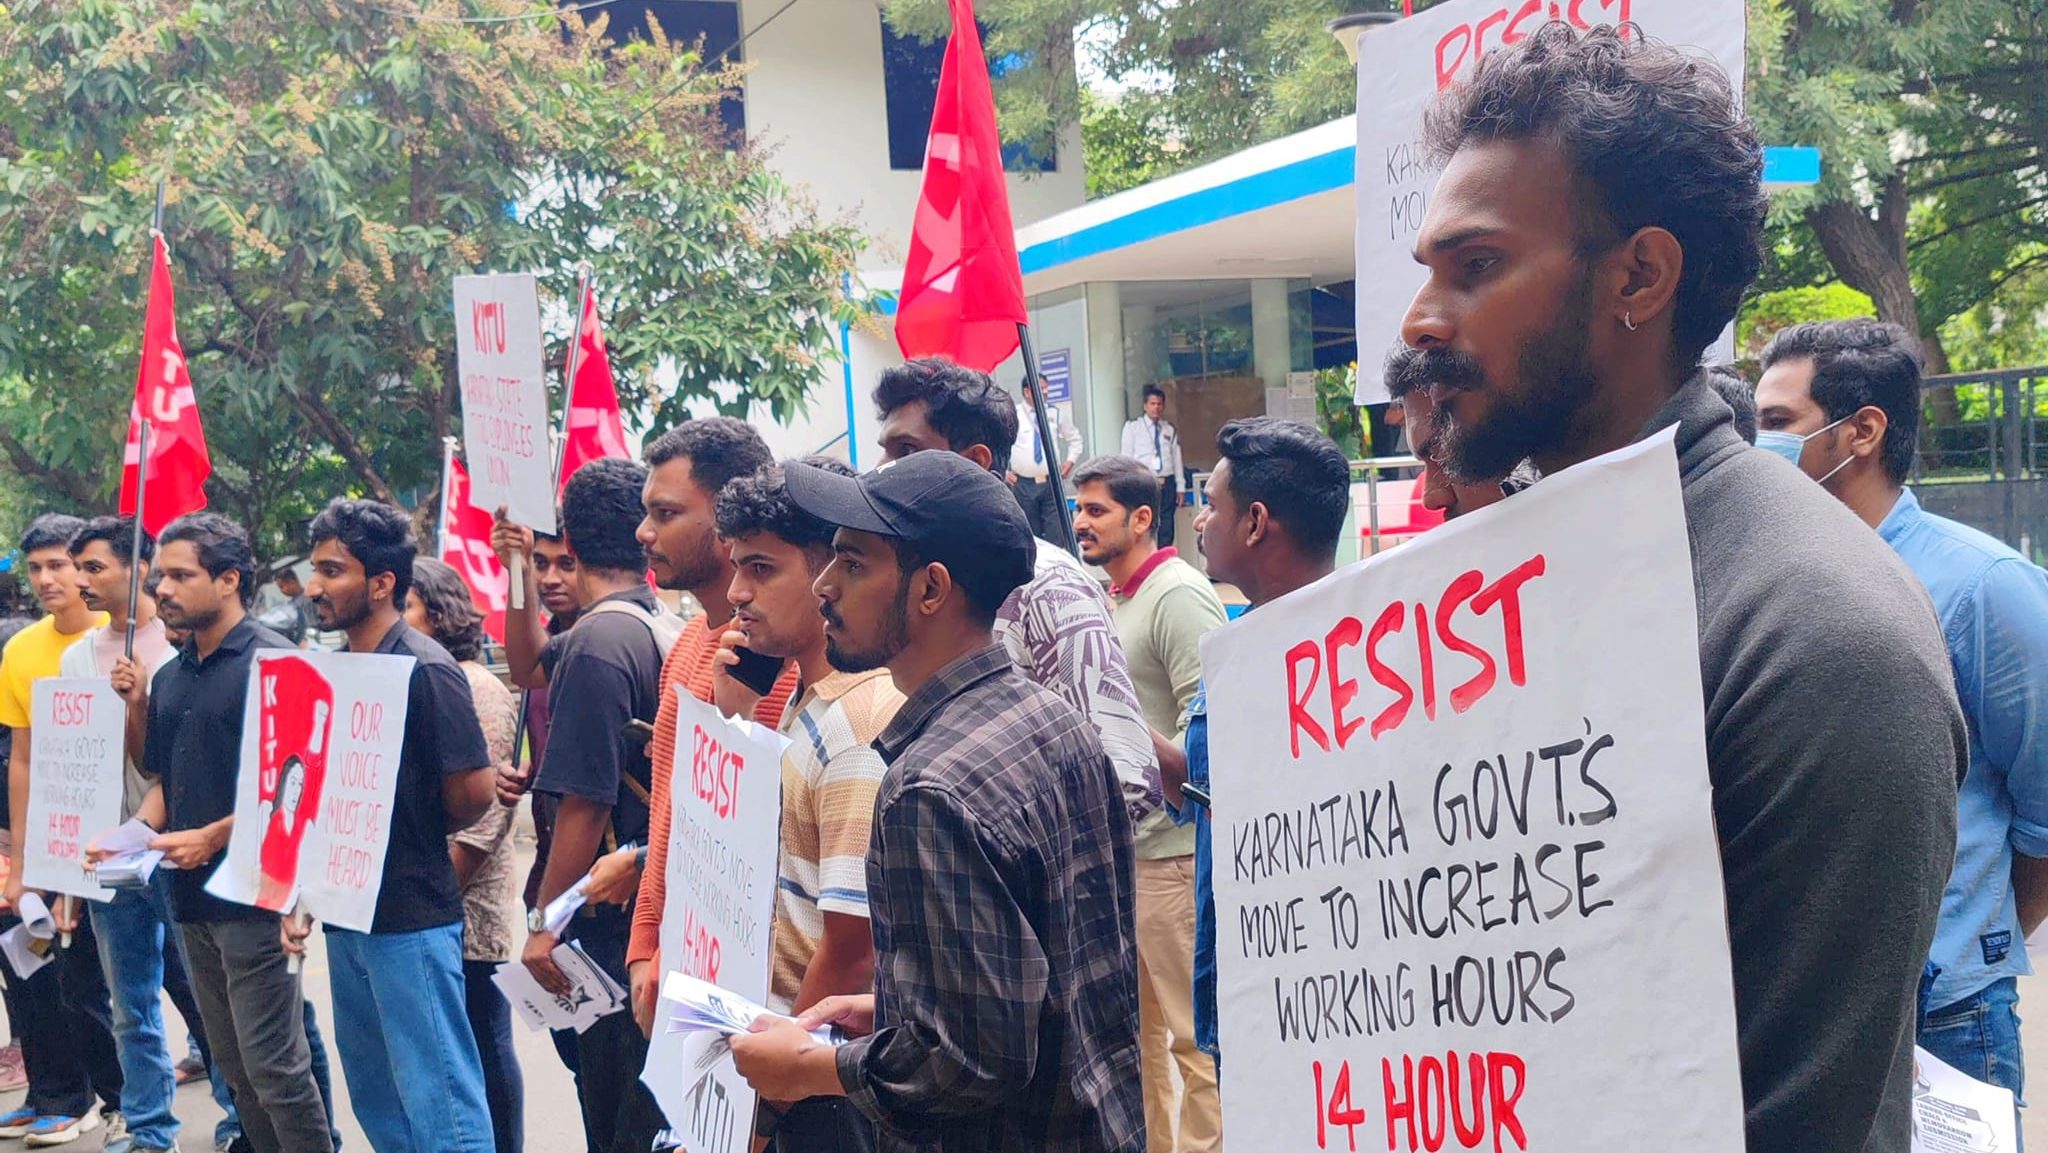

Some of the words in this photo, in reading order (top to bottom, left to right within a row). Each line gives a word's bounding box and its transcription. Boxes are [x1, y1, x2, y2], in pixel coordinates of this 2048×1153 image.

[472, 299, 507, 355] KITU
[1285, 553, 1546, 759] RESIST
[52, 690, 95, 728] RESIST
[263, 674, 278, 794] KITU
[351, 701, 384, 742] OUR
[339, 752, 382, 791] VOICE
[691, 723, 744, 822] RESIST
[325, 796, 360, 837] MUST
[364, 803, 383, 844] BE
[1232, 780, 1409, 884] KARNATAKA
[326, 843, 373, 890] HEARD
[729, 850, 754, 900] MOVE
[1240, 897, 1308, 958] MOVE
[1320, 886, 1360, 950] TO
[1378, 840, 1614, 940] INCREASE
[682, 902, 694, 964] 14
[694, 911, 721, 986] HOUR
[1274, 962, 1416, 1043] WORKING
[1430, 946, 1576, 1027] HOURS
[1312, 1059, 1365, 1152] 14
[1382, 1050, 1527, 1153] HOUR
